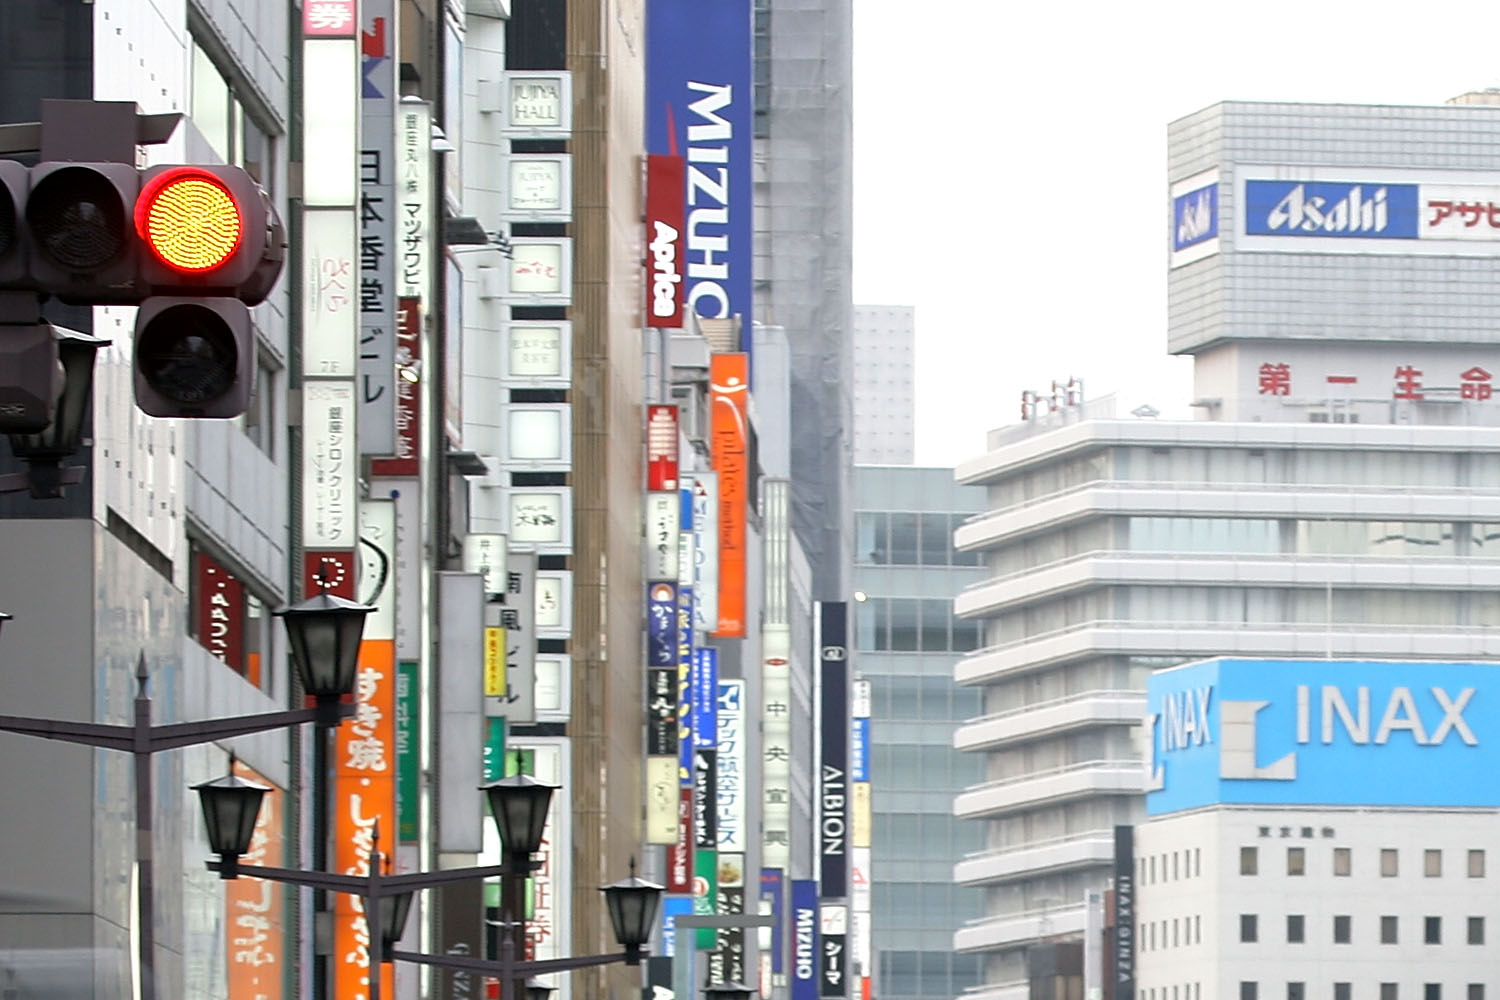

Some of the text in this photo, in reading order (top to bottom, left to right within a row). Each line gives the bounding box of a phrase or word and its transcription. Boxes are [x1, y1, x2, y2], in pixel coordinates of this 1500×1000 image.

[307, 0, 352, 28] 券
[515, 105, 556, 119] HALL
[687, 80, 733, 319] MIZUHO
[1267, 184, 1388, 233] Asahi
[649, 219, 682, 318] Aprica
[1258, 363, 1494, 402] 第一生命
[1161, 685, 1213, 752] INAX
[1296, 685, 1479, 745] INAX
[823, 766, 846, 855] ALBION
[796, 909, 814, 979] MIZUHO
